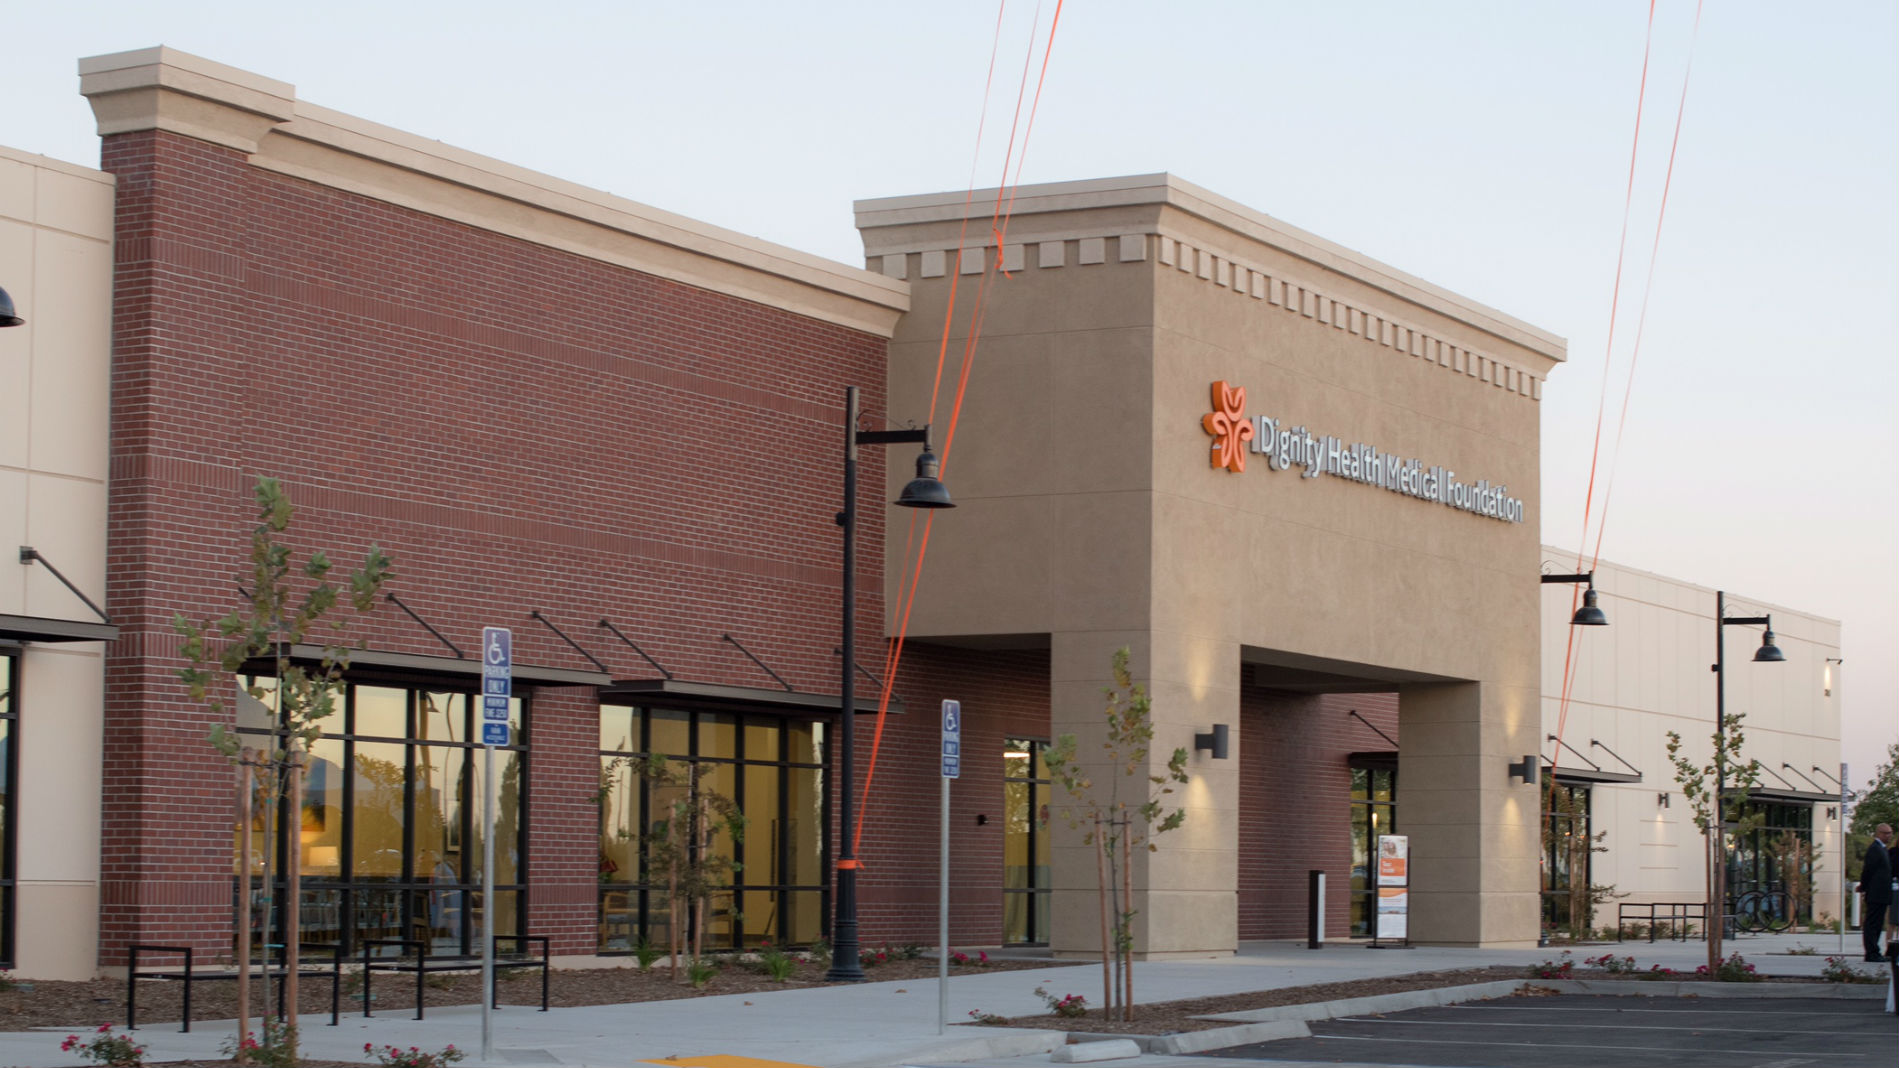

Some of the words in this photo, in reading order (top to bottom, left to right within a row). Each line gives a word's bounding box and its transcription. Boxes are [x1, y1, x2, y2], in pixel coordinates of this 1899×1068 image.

[1259, 416, 1323, 477] Dignity
[1328, 436, 1381, 482] Health
[1387, 453, 1443, 501] Medical
[1447, 470, 1523, 522] Foundation
